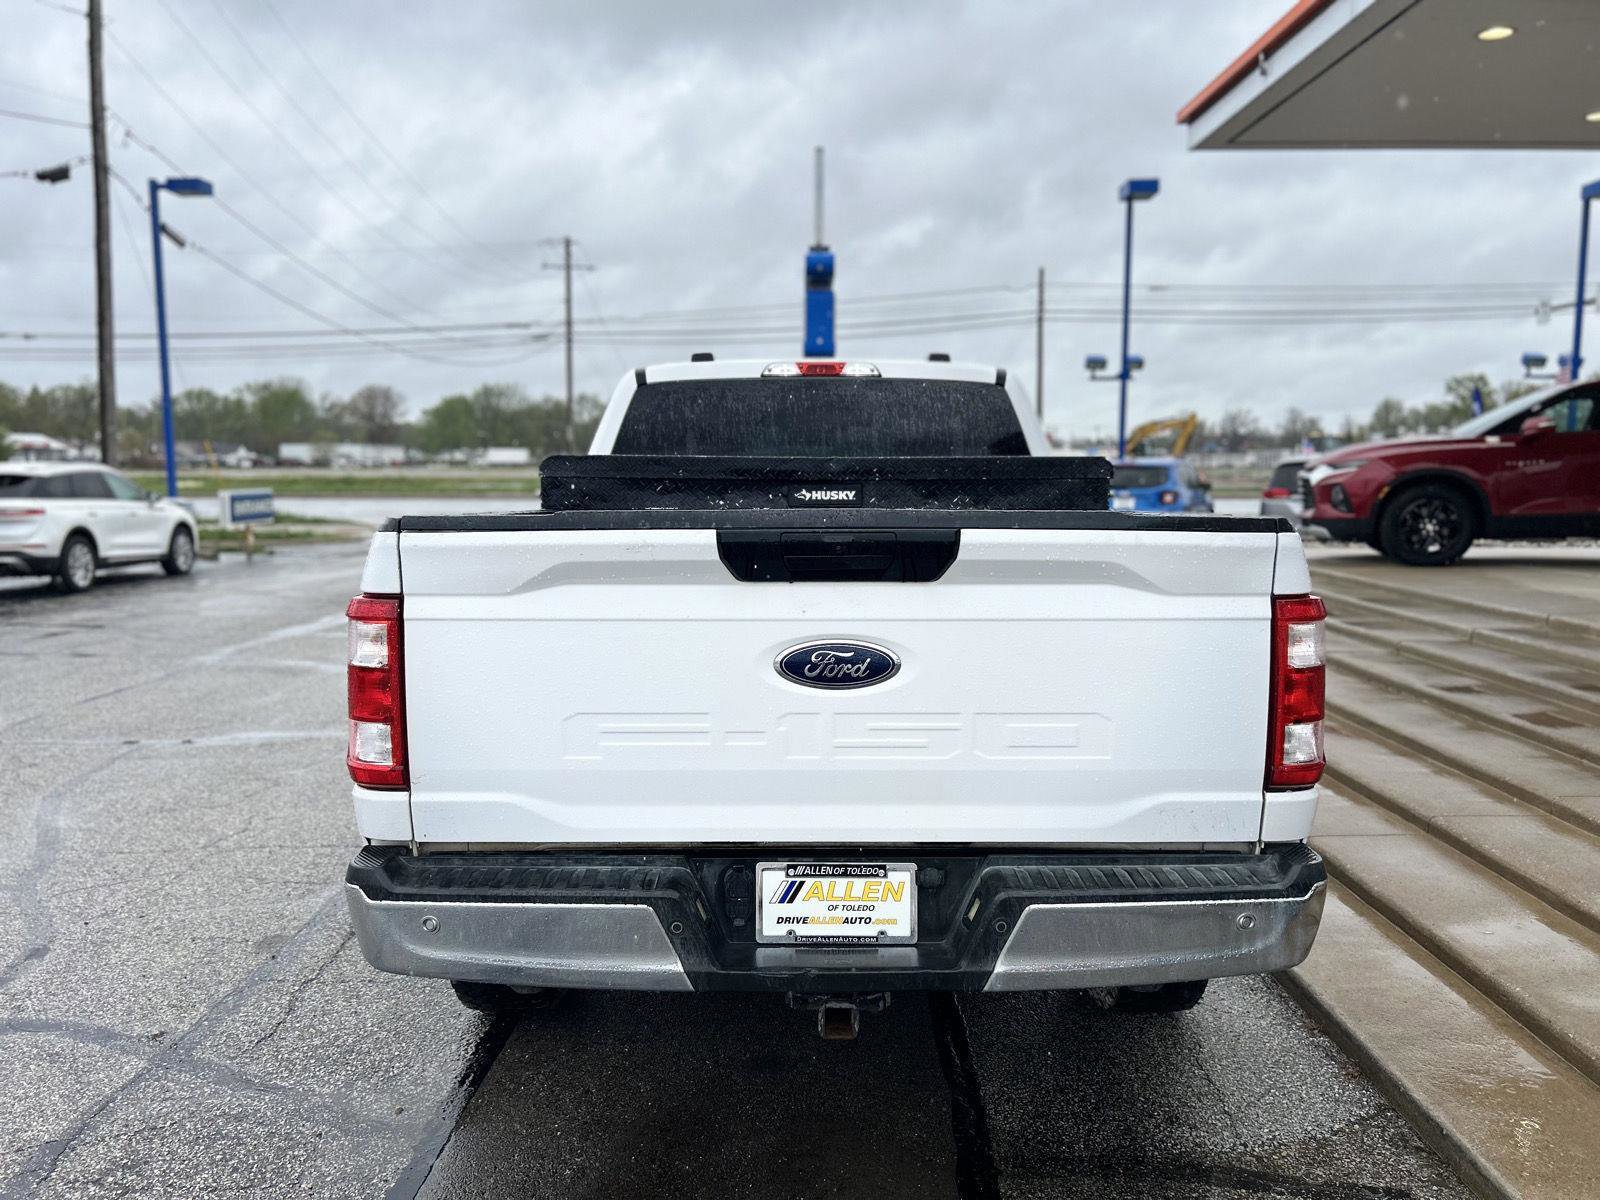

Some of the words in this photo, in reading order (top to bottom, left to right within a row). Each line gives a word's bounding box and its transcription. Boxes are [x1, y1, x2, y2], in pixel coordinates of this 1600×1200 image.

[804, 650, 872, 678] Ford
[562, 712, 1112, 760] F-150
[804, 866, 833, 875] ALLEN
[847, 867, 879, 875] TOLEDO
[802, 880, 905, 902] ALLEN
[827, 904, 840, 912] OF
[841, 904, 876, 912] TOLEDO
[776, 916, 898, 925] DRIVEALLENAUTO.com
